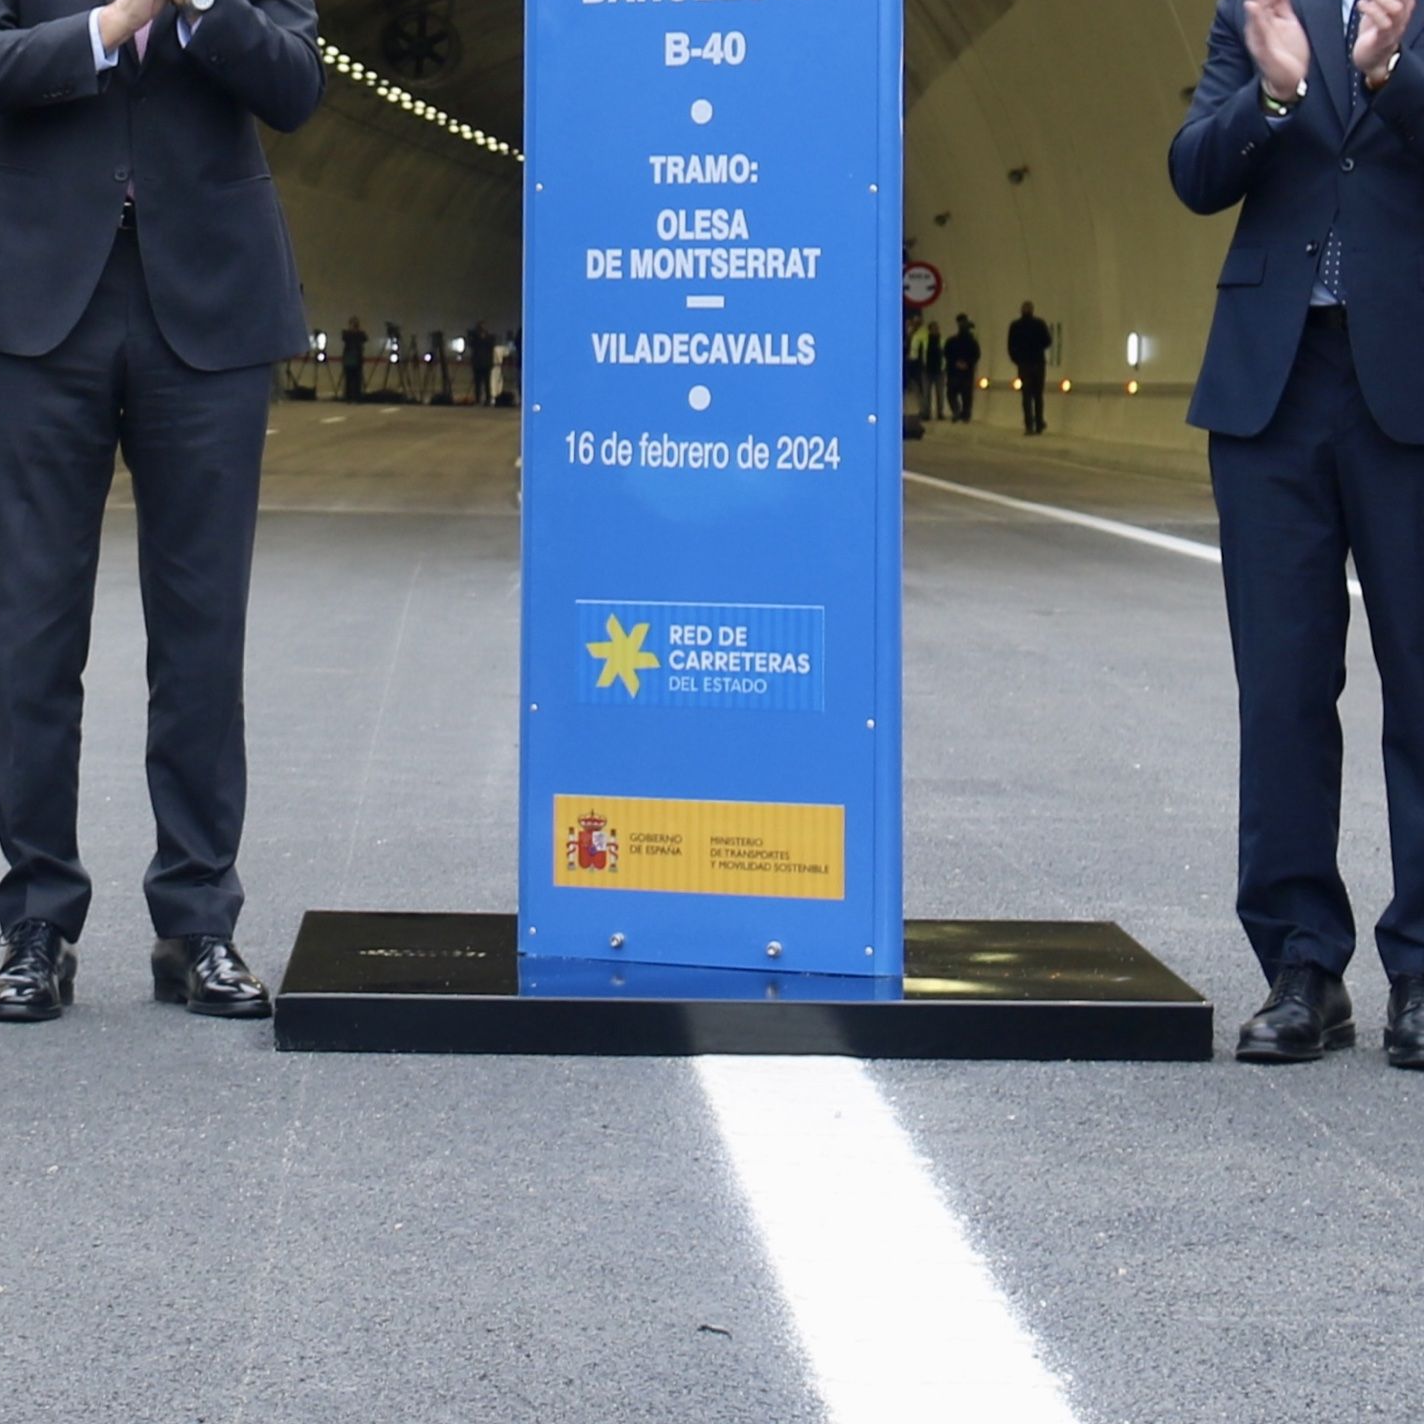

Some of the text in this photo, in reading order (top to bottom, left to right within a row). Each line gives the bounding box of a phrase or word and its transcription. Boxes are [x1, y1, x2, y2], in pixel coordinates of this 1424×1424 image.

[664, 31, 747, 66] B-40
[649, 154, 758, 184] TRAMO:
[657, 208, 749, 240] OLESA
[586, 248, 821, 279] DE MONTSERRAT
[592, 333, 815, 365] VILADECAVALLS
[566, 430, 840, 470] 16 de febrero de 2024
[669, 625, 747, 647] RED DE
[668, 651, 810, 674] CARRETERAS
[668, 677, 767, 694] DEL ESTADO
[630, 833, 683, 844] GOBIERNO
[710, 837, 763, 847] MINISTERIO
[630, 845, 682, 855] DE ESPAÑA
[710, 849, 789, 860] DE TRANSPORTES
[710, 861, 829, 874] Y MOVILIDAD SOSTENIBLE
